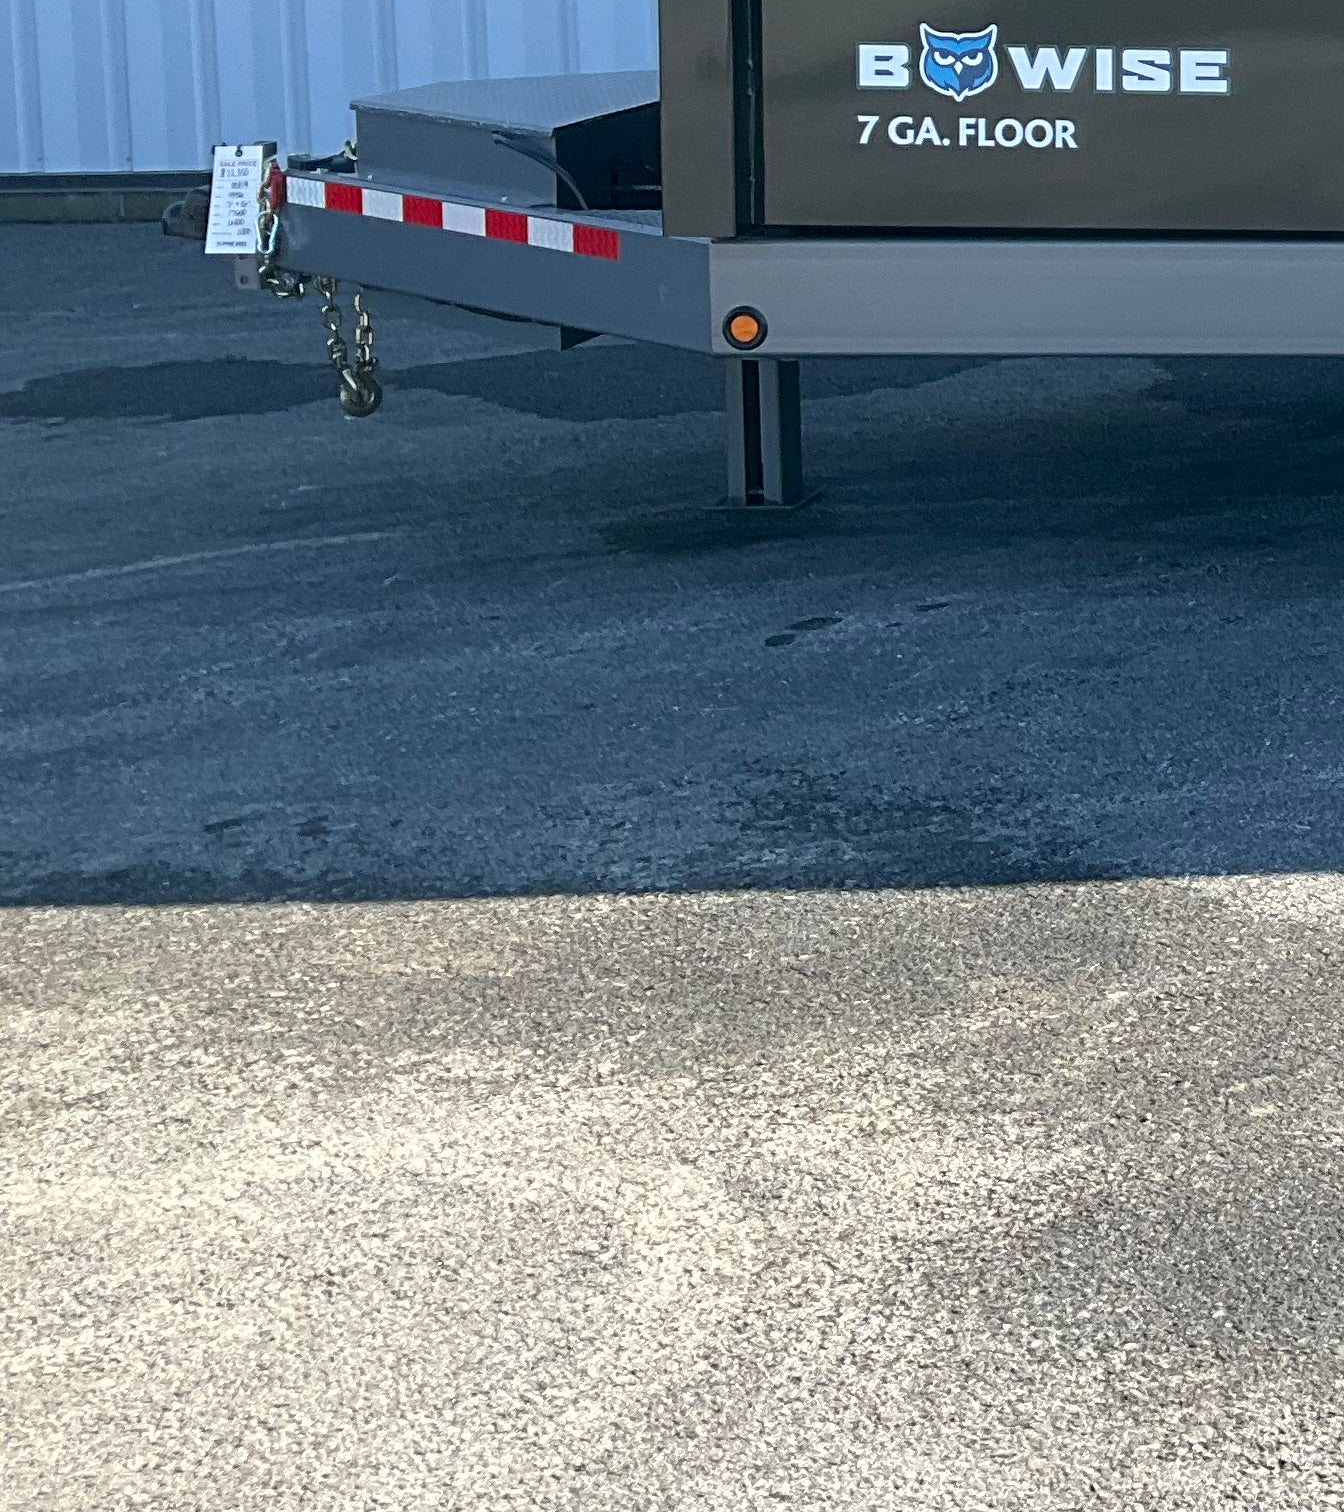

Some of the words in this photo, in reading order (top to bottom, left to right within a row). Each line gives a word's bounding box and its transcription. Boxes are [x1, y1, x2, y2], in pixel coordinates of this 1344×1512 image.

[857, 115, 880, 145] 7
[887, 115, 951, 147] GA.
[958, 117, 1079, 149] FLOOR
